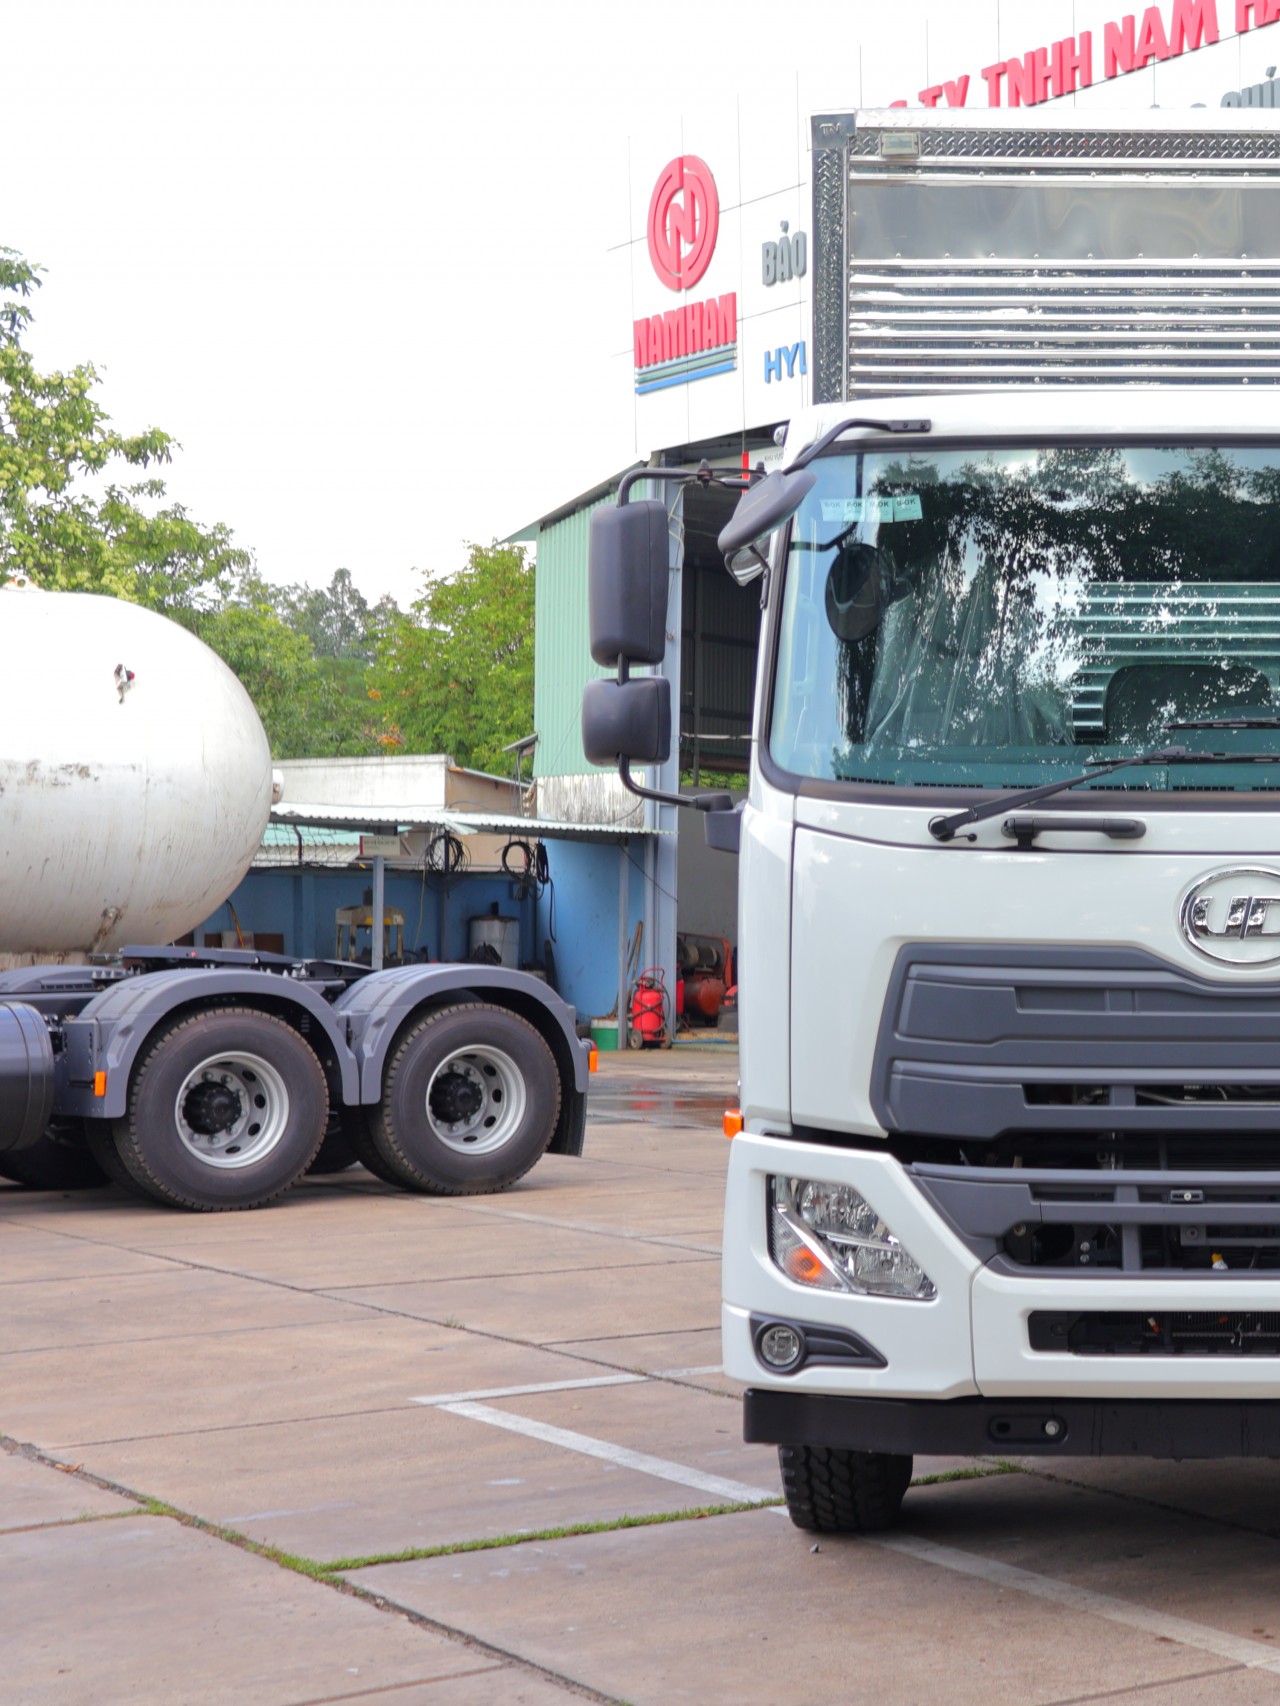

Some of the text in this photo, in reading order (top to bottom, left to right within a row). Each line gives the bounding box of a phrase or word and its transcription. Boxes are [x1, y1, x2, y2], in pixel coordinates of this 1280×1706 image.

[981, 31, 1092, 108] TNHH
[1104, 0, 1219, 79] NAM
[762, 219, 807, 286] BẢO
[633, 291, 737, 370] NAMHAN
